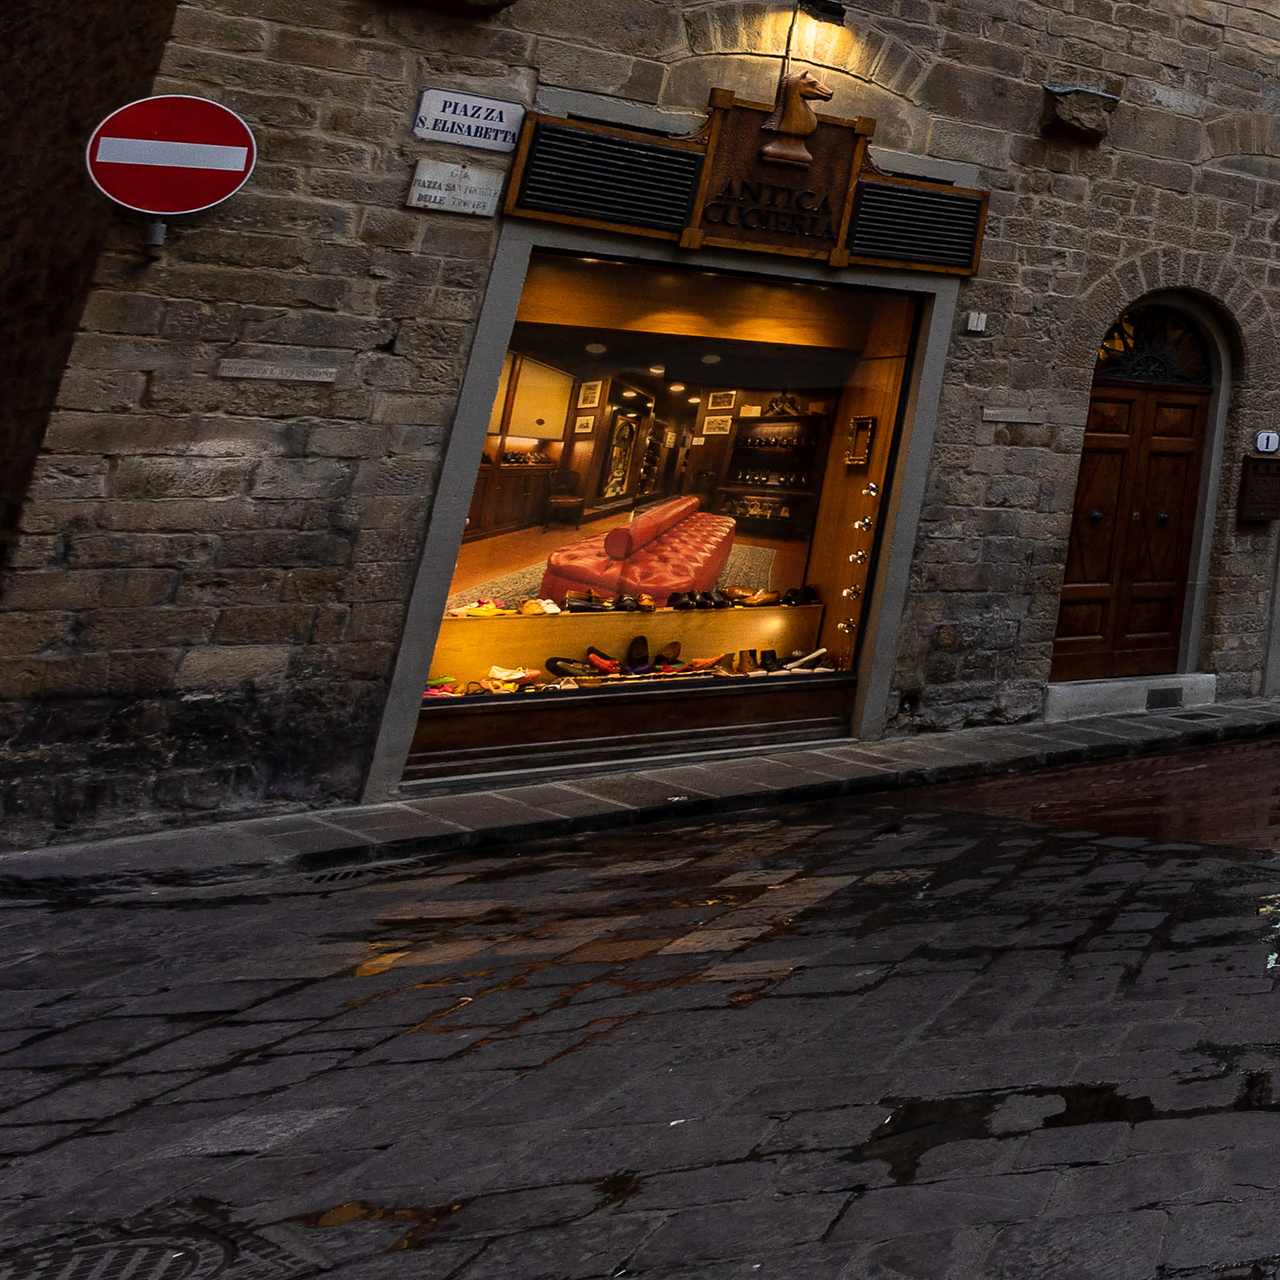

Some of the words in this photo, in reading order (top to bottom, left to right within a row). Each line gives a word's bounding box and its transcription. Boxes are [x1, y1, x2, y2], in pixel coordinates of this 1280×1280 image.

[441, 100, 504, 123] PIAZZA
[412, 178, 442, 191] PIAZZA
[715, 178, 833, 214] ANTICA
[416, 193, 446, 206] DELLE
[703, 201, 837, 238] CUOIERIA
